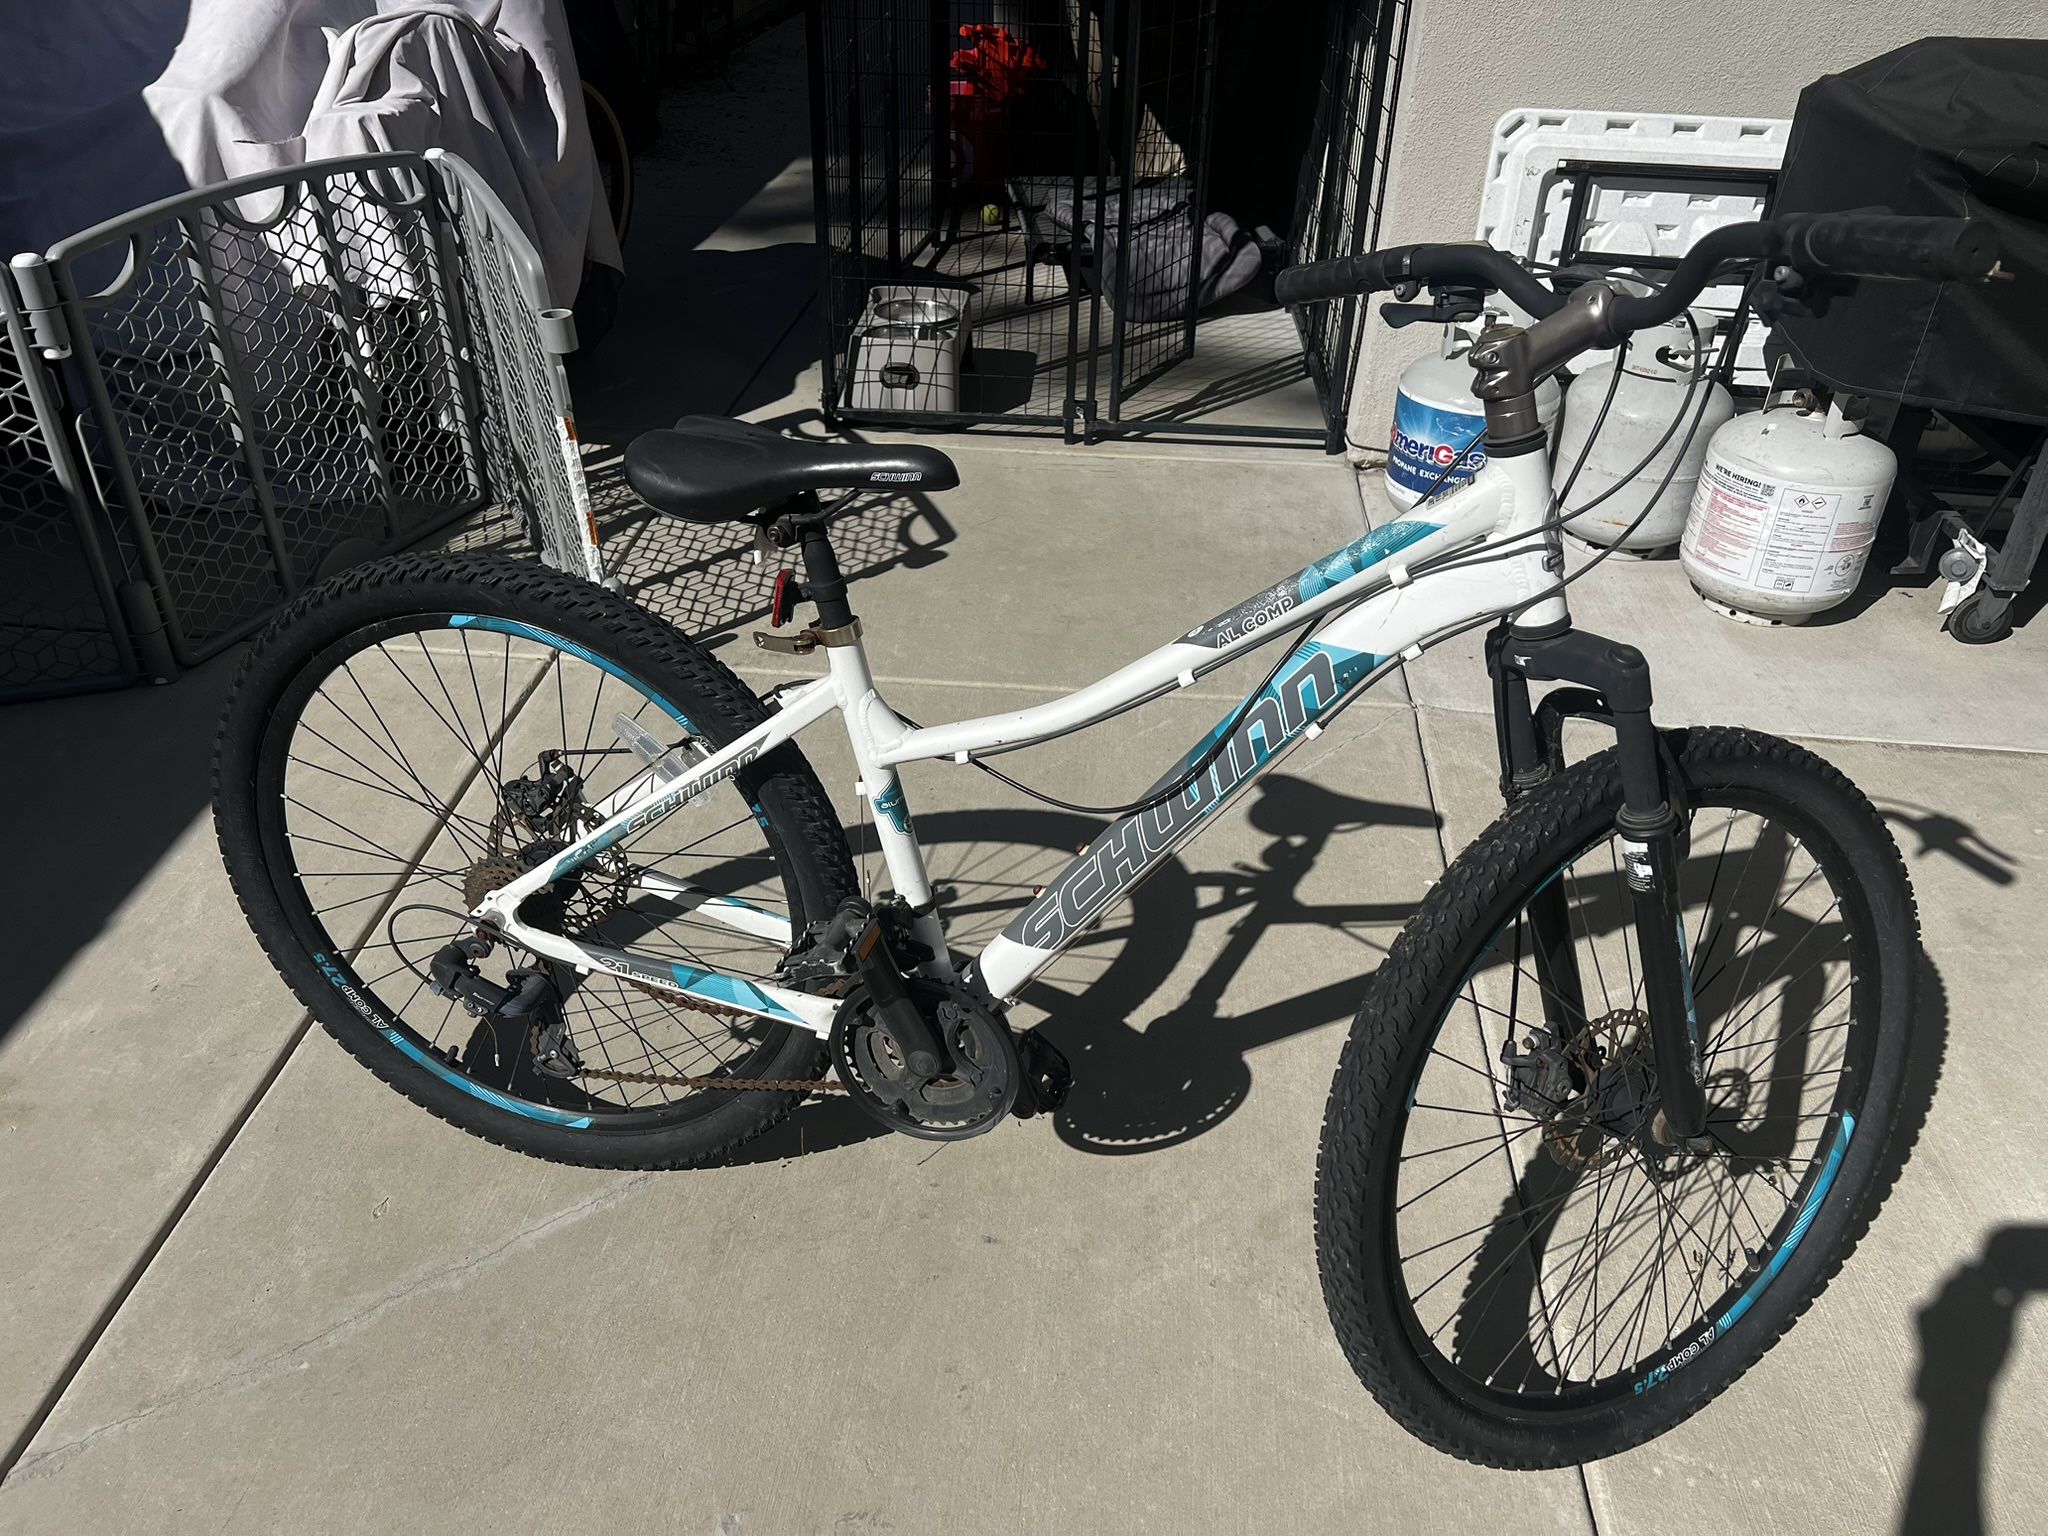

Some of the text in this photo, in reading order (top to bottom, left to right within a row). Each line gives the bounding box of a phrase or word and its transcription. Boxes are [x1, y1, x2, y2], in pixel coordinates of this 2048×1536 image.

[870, 471, 923, 482] SCHWINN
[1715, 463, 1762, 489] WE'RE HIRING!
[1216, 596, 1294, 649] AL COMP
[1022, 651, 1338, 951] SCHWINN
[600, 957, 679, 988] 21 SPEED
[341, 984, 372, 1015] COMP
[371, 1013, 390, 1029] AL
[1698, 1326, 1715, 1346] AL
[1666, 1341, 1700, 1372] COMP
